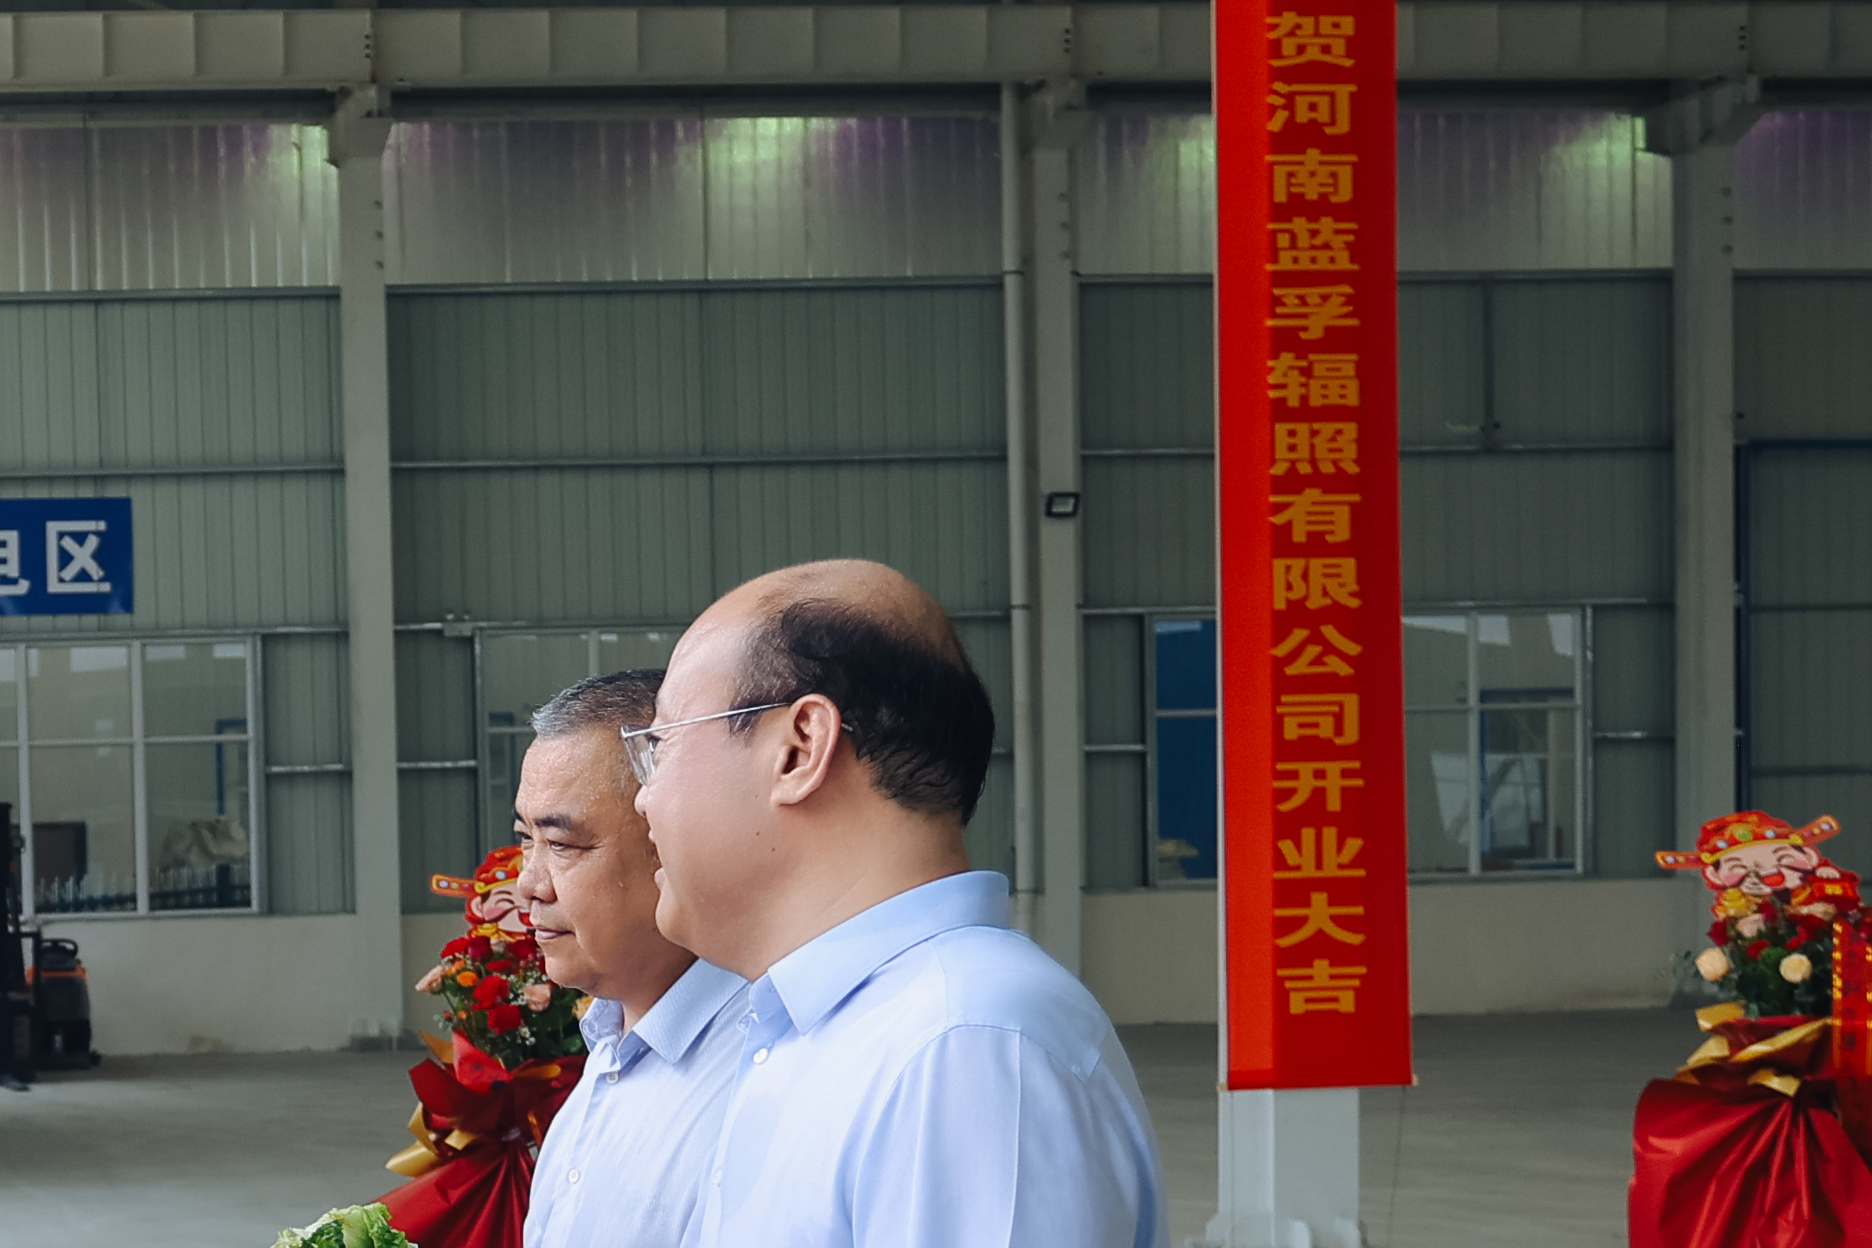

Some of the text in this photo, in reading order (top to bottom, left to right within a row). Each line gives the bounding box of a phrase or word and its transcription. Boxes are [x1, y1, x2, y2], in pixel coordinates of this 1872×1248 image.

[1264, 10, 1368, 1015] 贺河南蓝孚辐照有限公司开业大吉
